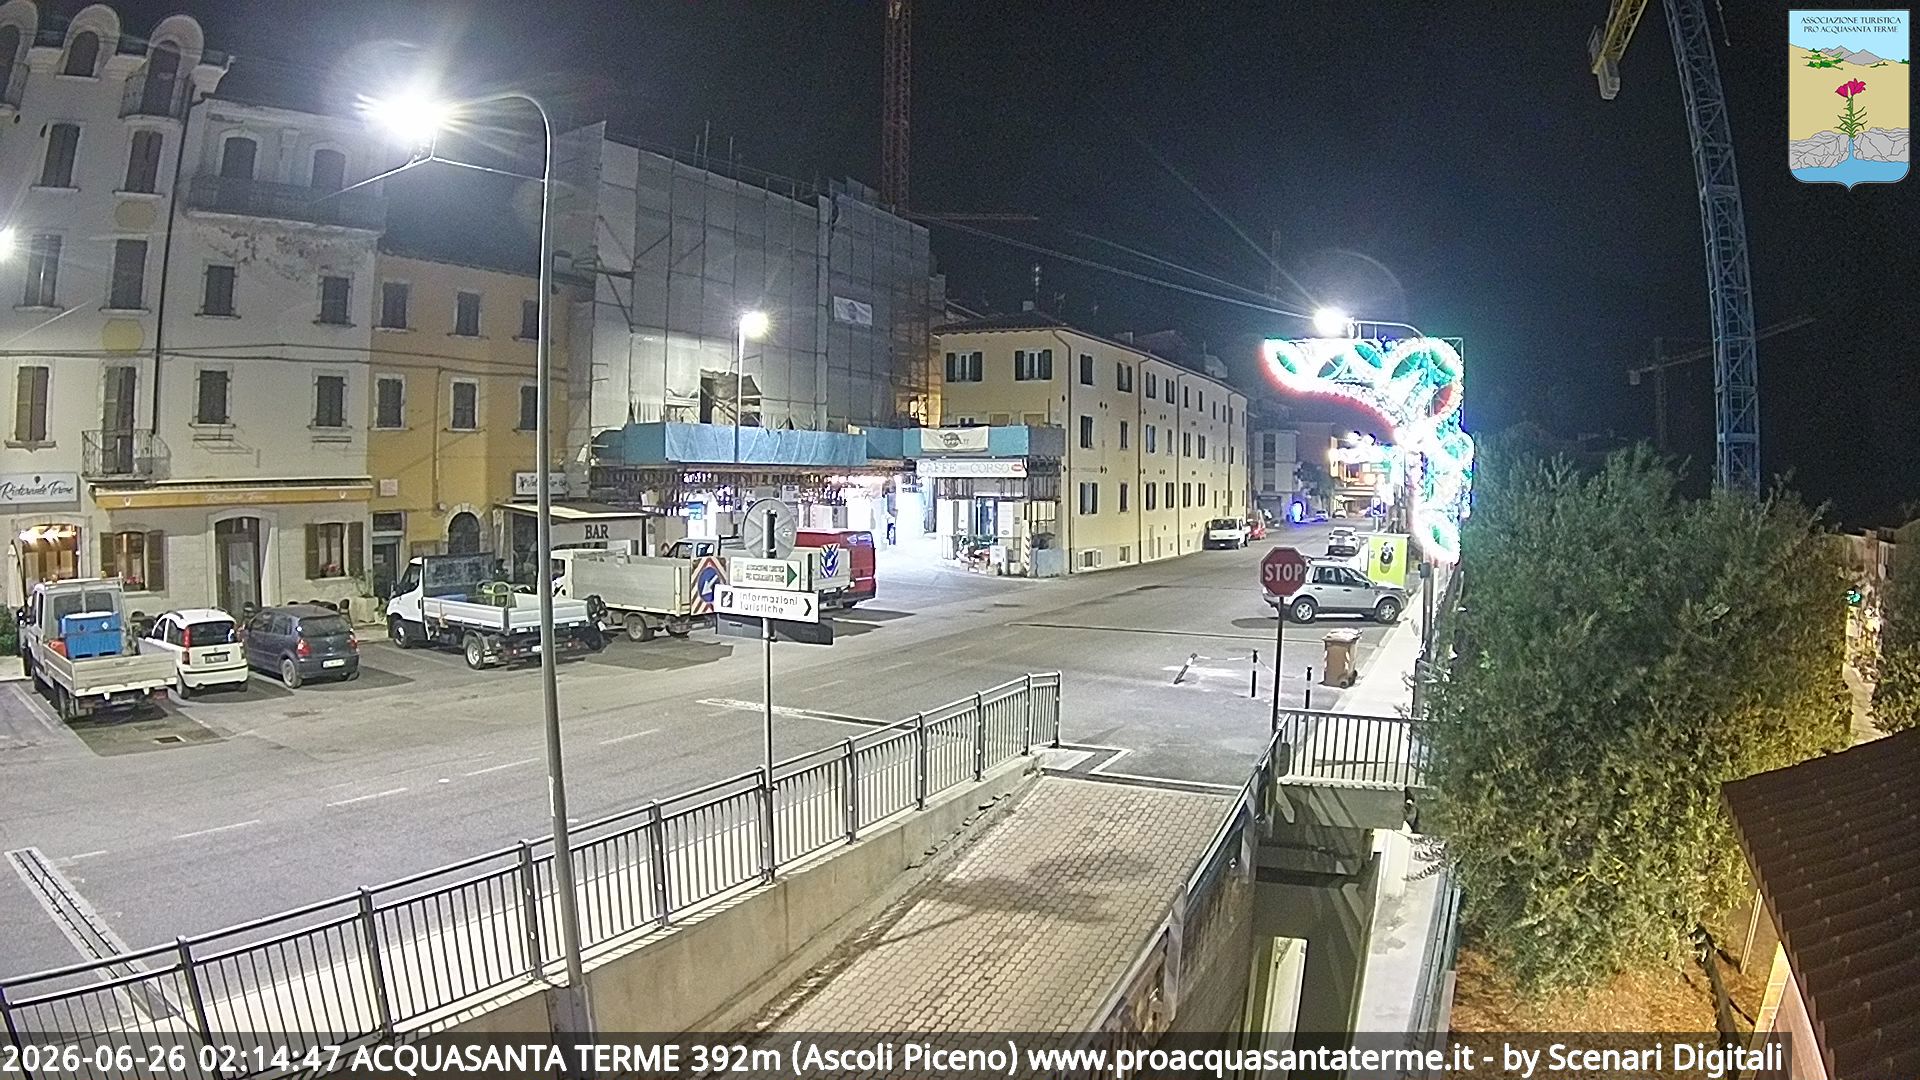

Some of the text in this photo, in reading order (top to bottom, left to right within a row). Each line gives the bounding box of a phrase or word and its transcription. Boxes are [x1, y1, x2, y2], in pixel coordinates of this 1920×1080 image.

[970, 463, 1010, 473] CORSO
[584, 524, 609, 540] BAR
[1265, 563, 1303, 582] STOP
